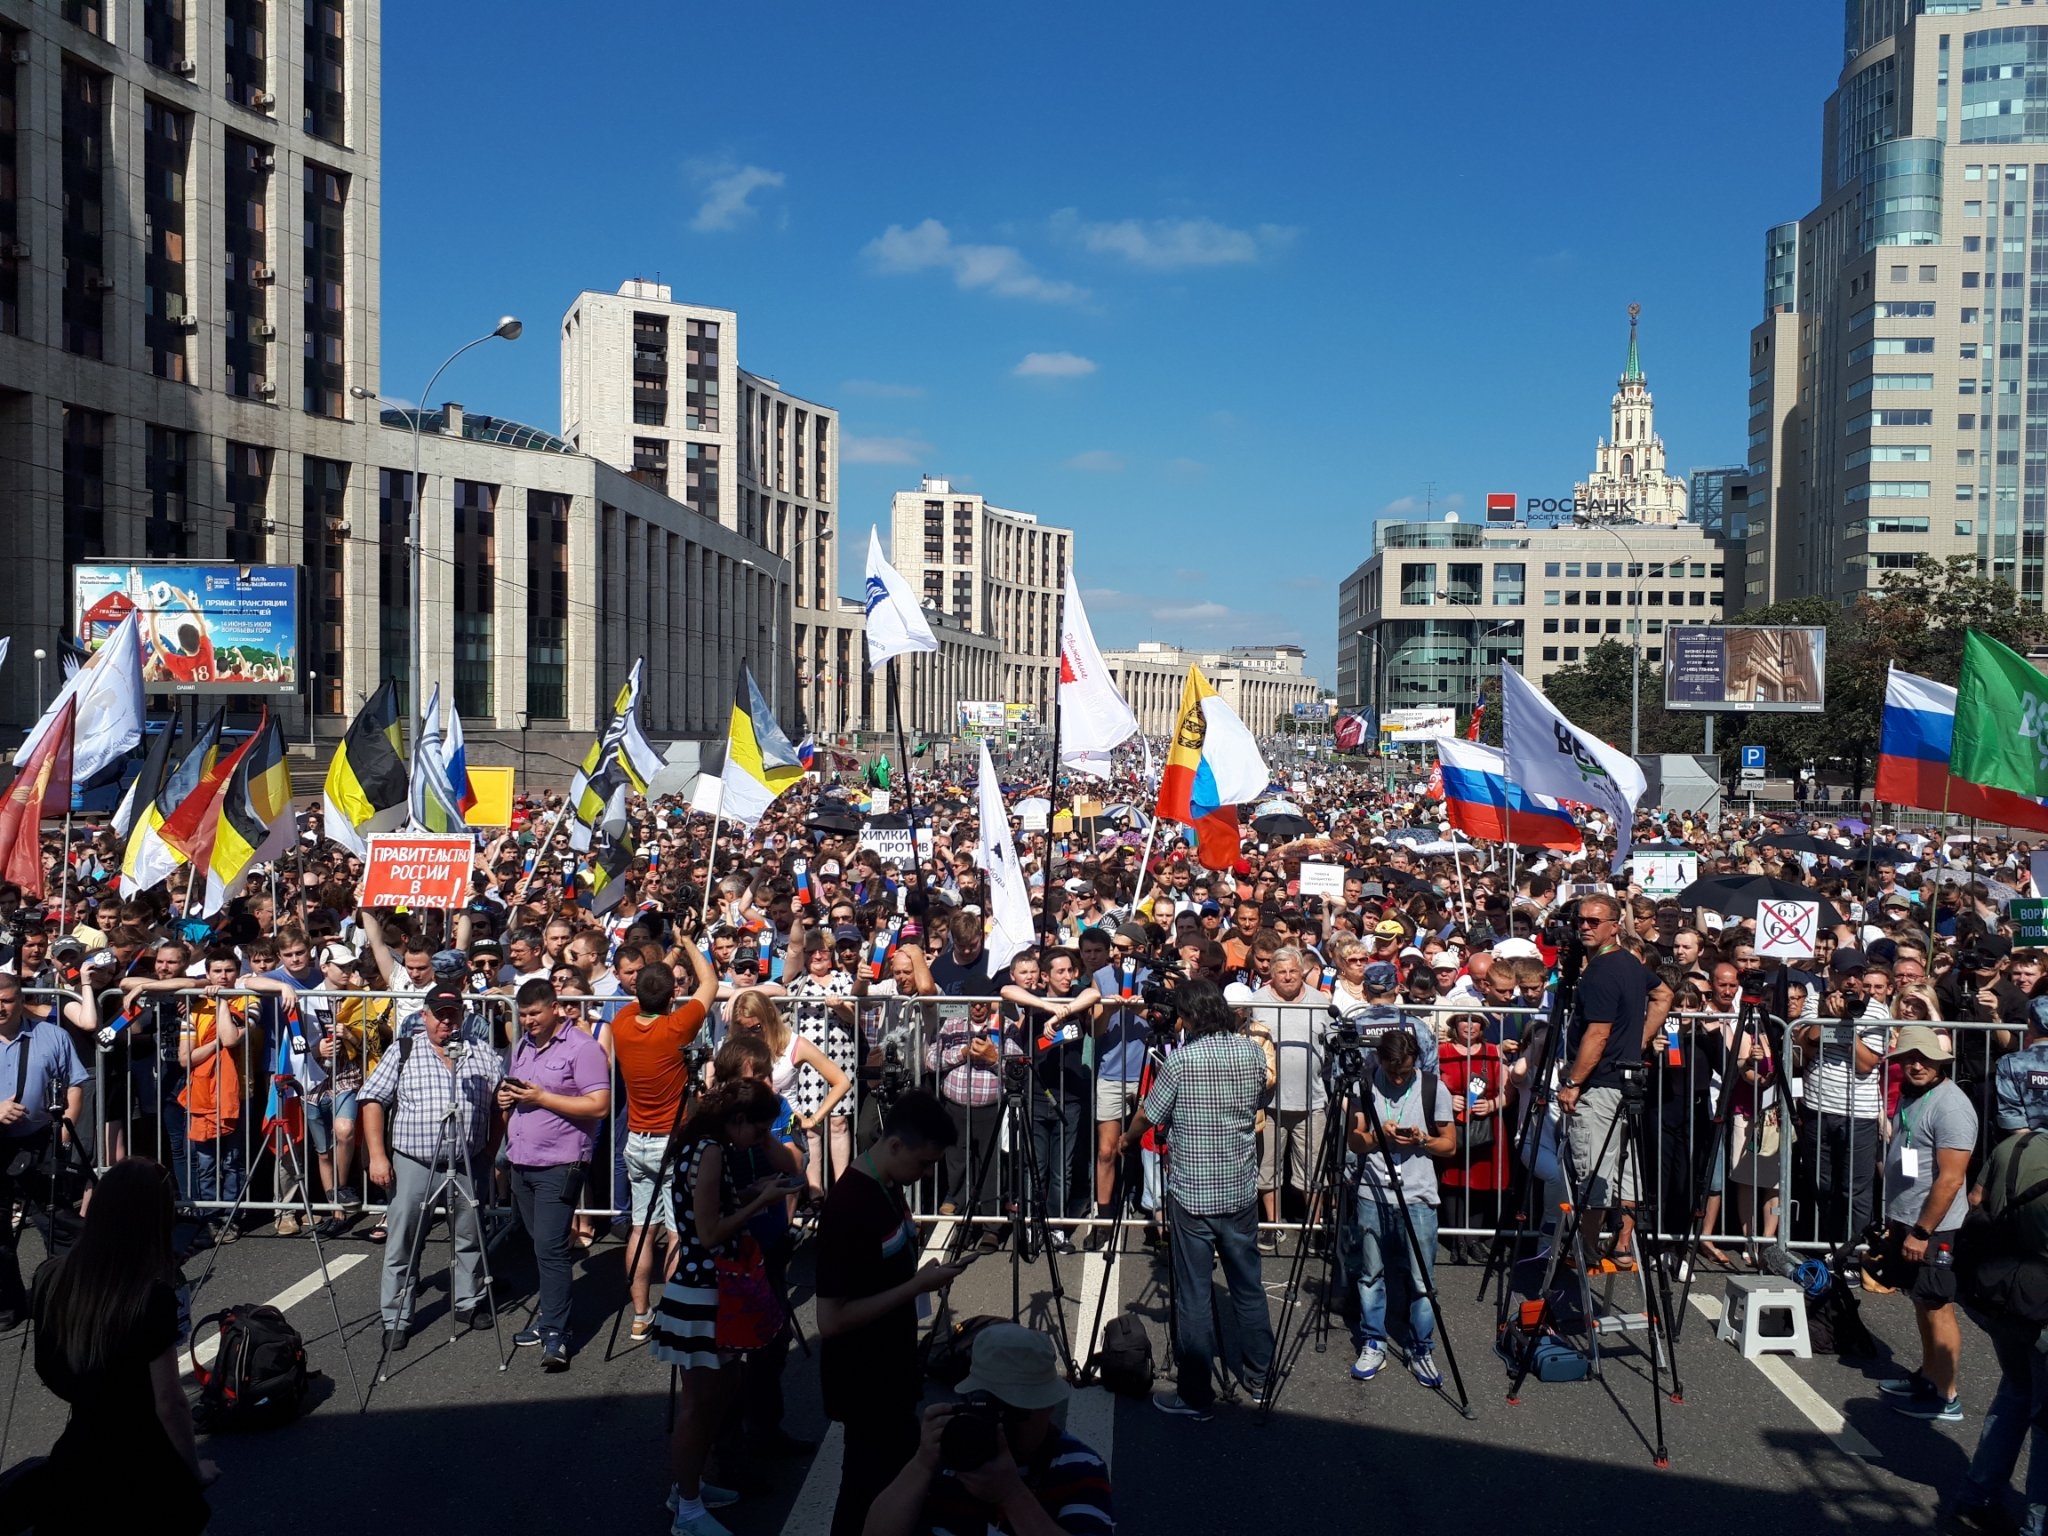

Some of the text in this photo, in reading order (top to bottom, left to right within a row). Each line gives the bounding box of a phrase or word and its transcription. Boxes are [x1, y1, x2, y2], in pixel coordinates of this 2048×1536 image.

[1528, 499, 1632, 513] РОСБАНК
[1064, 632, 1088, 680] Движение
[191, 666, 210, 682] 18
[1748, 749, 1760, 765] P
[861, 831, 908, 841] ХИМКИ
[374, 847, 471, 863] ПРАВИТЕЛЬСТВО
[390, 864, 451, 881] РОССИИ
[410, 880, 422, 894] В
[1777, 904, 1798, 918] 63
[2021, 908, 2048, 920] ВОРУ
